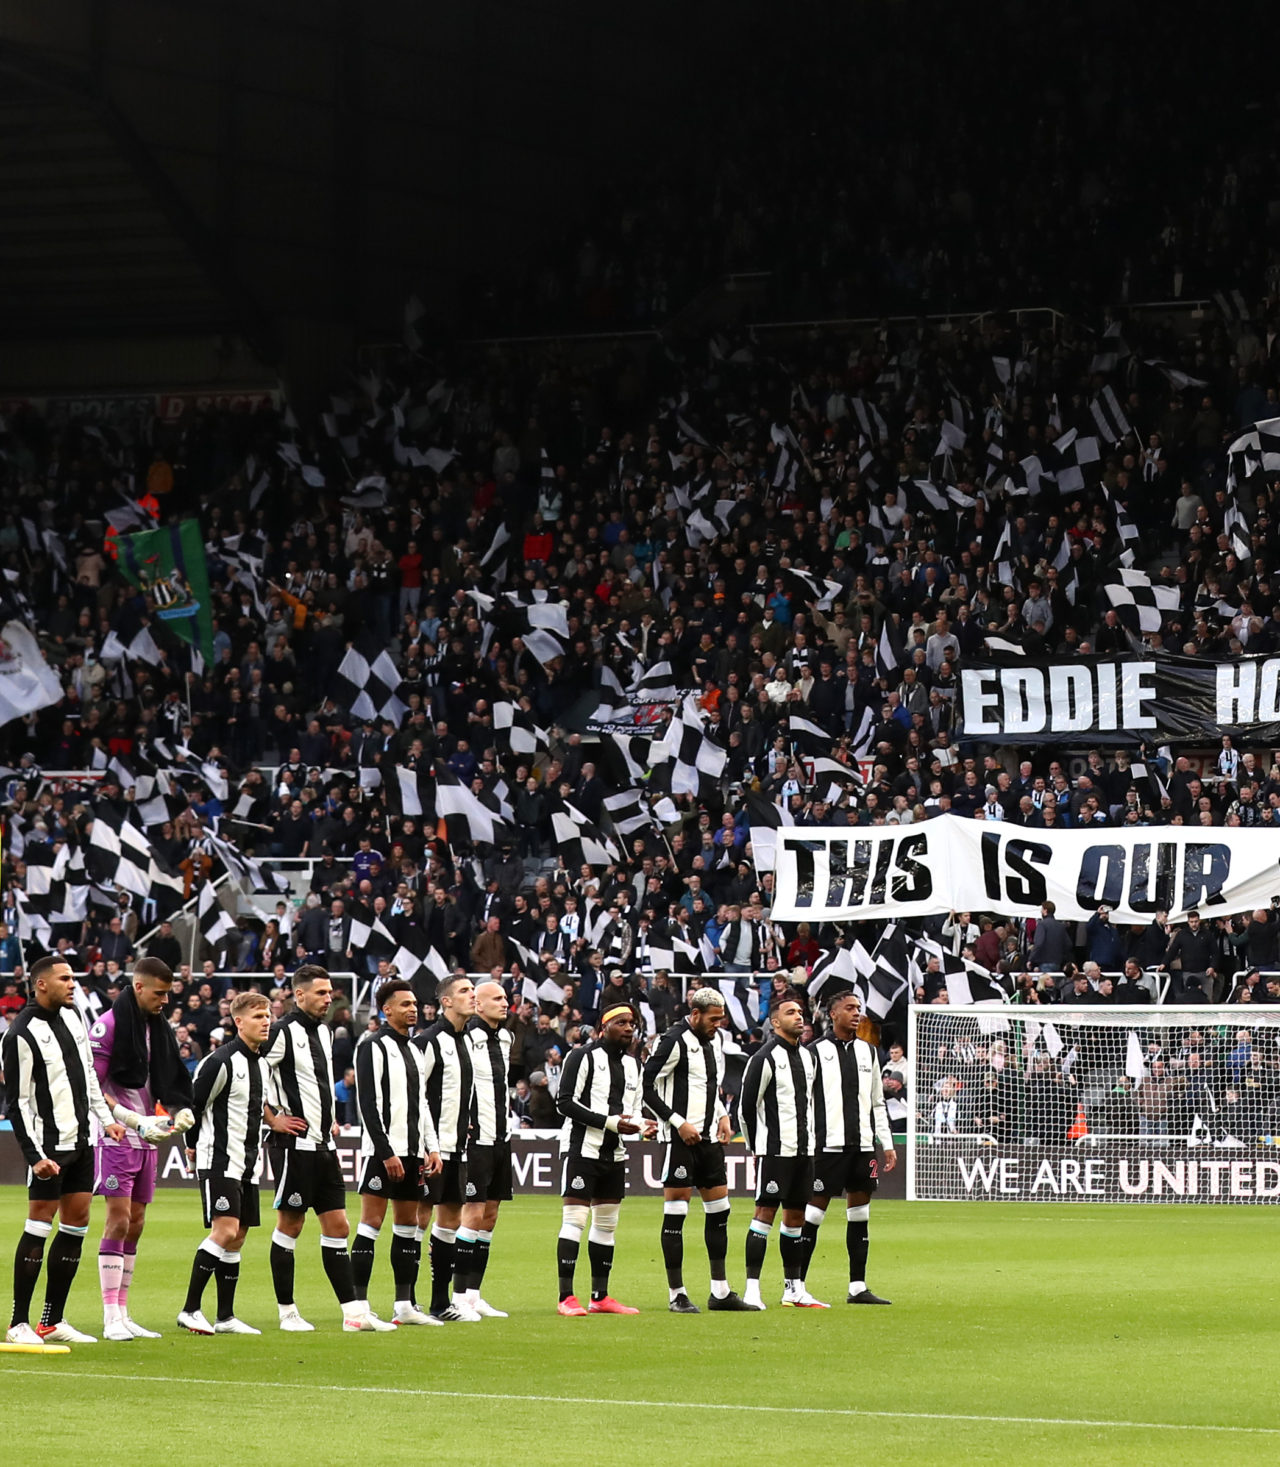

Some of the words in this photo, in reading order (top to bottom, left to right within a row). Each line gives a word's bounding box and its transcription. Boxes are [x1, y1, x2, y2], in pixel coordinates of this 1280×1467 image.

[961, 661, 1157, 735] EDDIE
[783, 831, 933, 908] THIS
[981, 830, 1053, 905] IS
[1075, 842, 1232, 914] OUR
[957, 1157, 1020, 1194] WE
[1031, 1159, 1106, 1195] ARE
